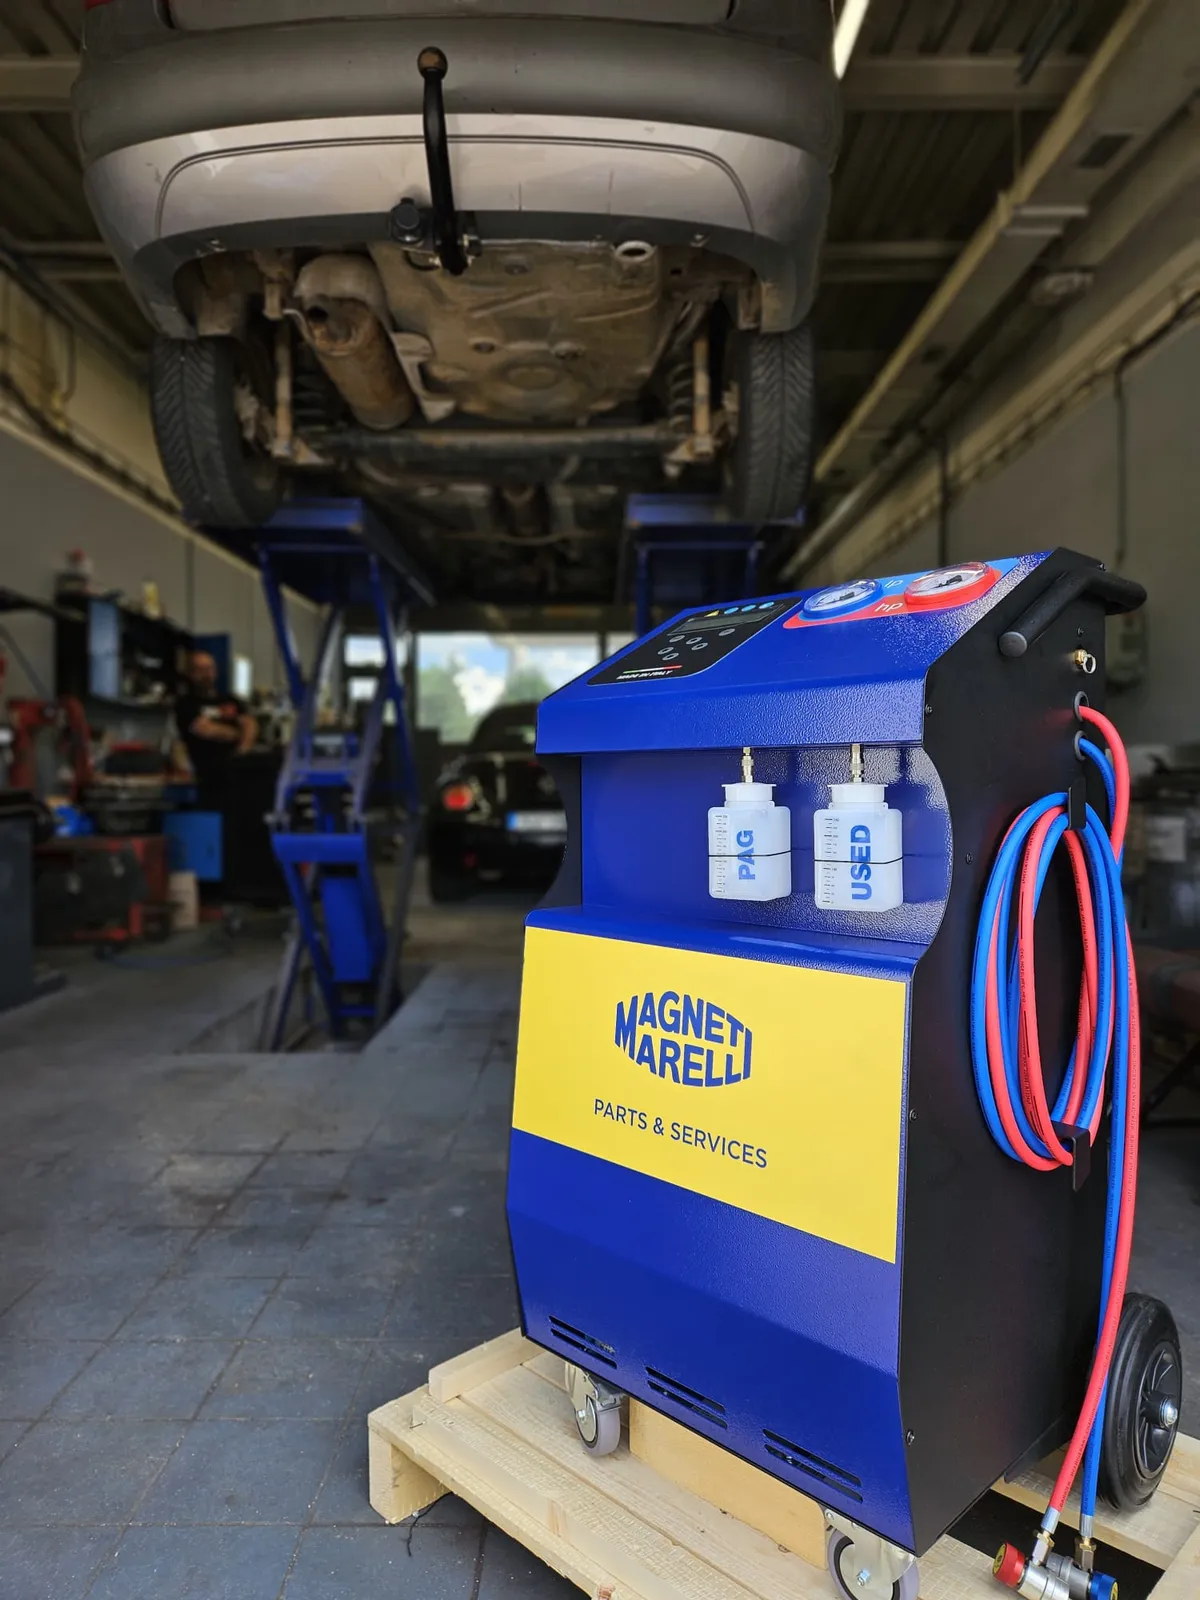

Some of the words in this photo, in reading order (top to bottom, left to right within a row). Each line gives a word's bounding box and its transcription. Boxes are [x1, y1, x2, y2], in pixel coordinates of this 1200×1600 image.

[874, 601, 904, 612] hp
[883, 579, 904, 589] lp
[736, 830, 755, 880] PAG
[850, 825, 872, 900] USED
[614, 991, 752, 1066] MAGNETI
[614, 1008, 752, 1087] MARELLI
[594, 1098, 647, 1130] PARTS
[653, 1117, 664, 1136] &
[671, 1122, 767, 1168] SERVICES
